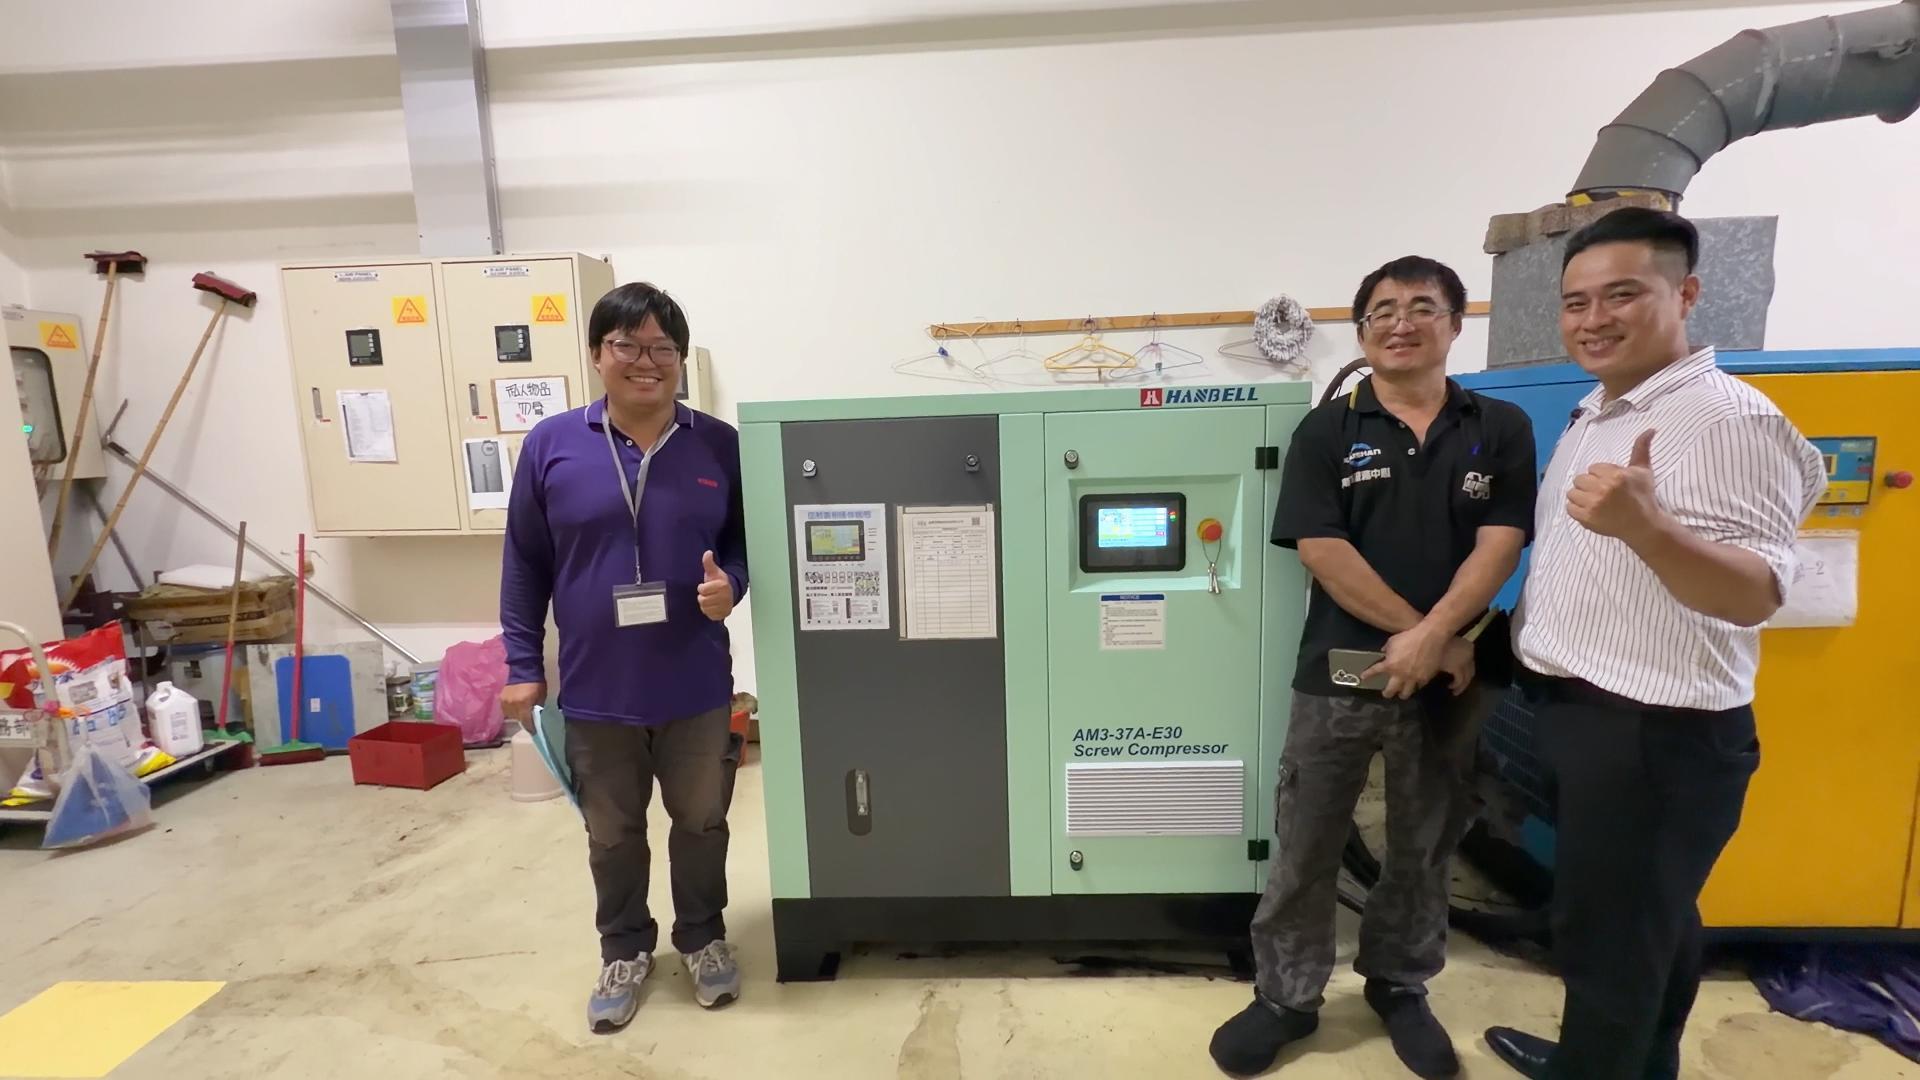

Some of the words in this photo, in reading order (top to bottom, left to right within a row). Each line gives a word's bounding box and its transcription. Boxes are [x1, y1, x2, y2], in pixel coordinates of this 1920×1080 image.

[1166, 387, 1259, 404] HANBELL
[1072, 726, 1183, 741] AM3-37A-E30
[1074, 744, 1124, 757] Screw
[1127, 743, 1229, 758] Compressor
